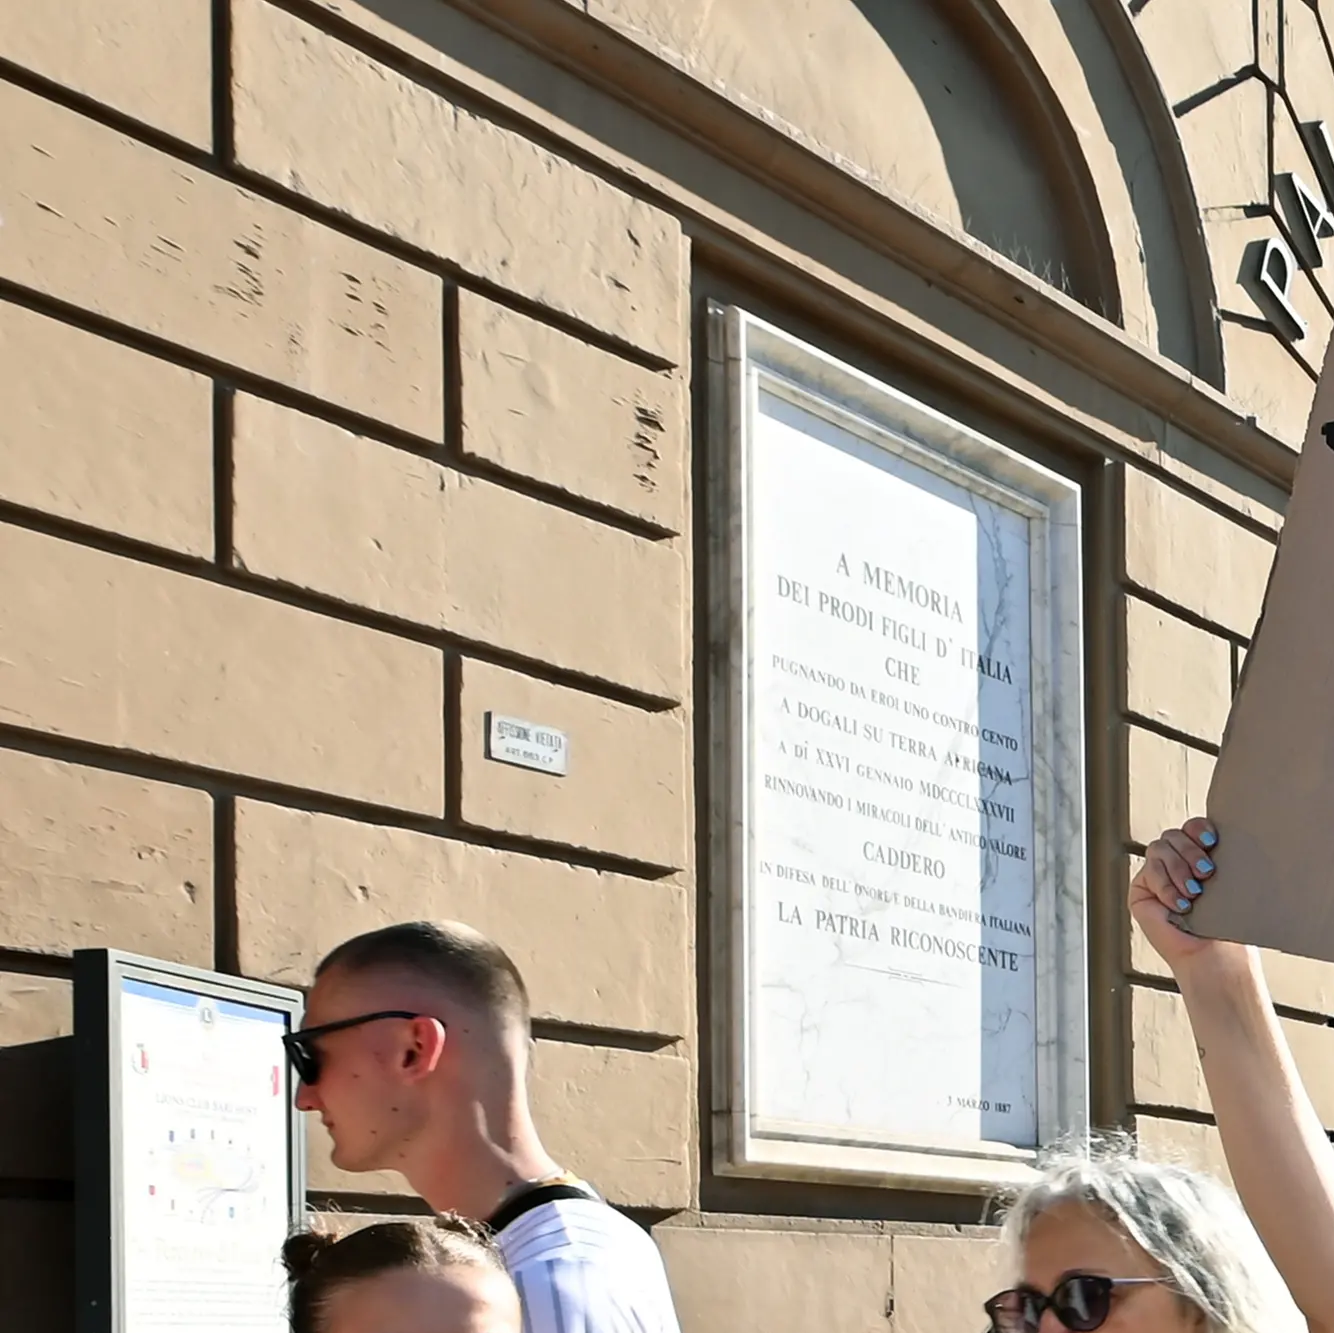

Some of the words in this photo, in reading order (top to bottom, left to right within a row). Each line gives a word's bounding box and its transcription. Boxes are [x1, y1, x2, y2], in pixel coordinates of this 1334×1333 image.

[836, 551, 850, 578] A
[863, 560, 963, 624] MEMORIA
[777, 574, 810, 608] DEI
[818, 590, 873, 631] PRODI
[881, 615, 926, 652] FIGLI
[961, 646, 1012, 685] ITALIA
[772, 653, 846, 692] PUGNANDO
[849, 681, 867, 700] DA
[870, 688, 899, 711] EROI
[904, 699, 929, 721] UNO
[932, 711, 980, 738] CONTRO
[981, 728, 1018, 752] CENTO
[885, 656, 921, 686] CHE
[779, 696, 791, 714] A
[798, 701, 857, 735] DOGALI
[862, 723, 883, 744] SU
[888, 731, 937, 762] TERRA
[944, 751, 1012, 786] AFRICANA
[779, 740, 788, 755] A
[816, 747, 850, 773] XXVI
[856, 763, 913, 792] GENNAIO
[764, 773, 844, 809] RINNOVANDO
[847, 797, 852, 812] I
[855, 800, 911, 829] MIRACOLI
[949, 827, 987, 850] ANTICO
[988, 838, 1027, 861] VALORE
[863, 840, 945, 880] CADDERO
[760, 860, 773, 875] IN
[776, 864, 816, 886] DIFESA
[854, 882, 891, 904] ONORE
[903, 895, 936, 914] DELLA
[938, 903, 987, 927] BANDIERA
[988, 915, 1032, 938] ITALIANA
[778, 900, 803, 926] LA
[815, 908, 880, 942] PATRIA
[889, 925, 1019, 972] RICONOSCENTE
[956, 1097, 990, 1111] MARZO
